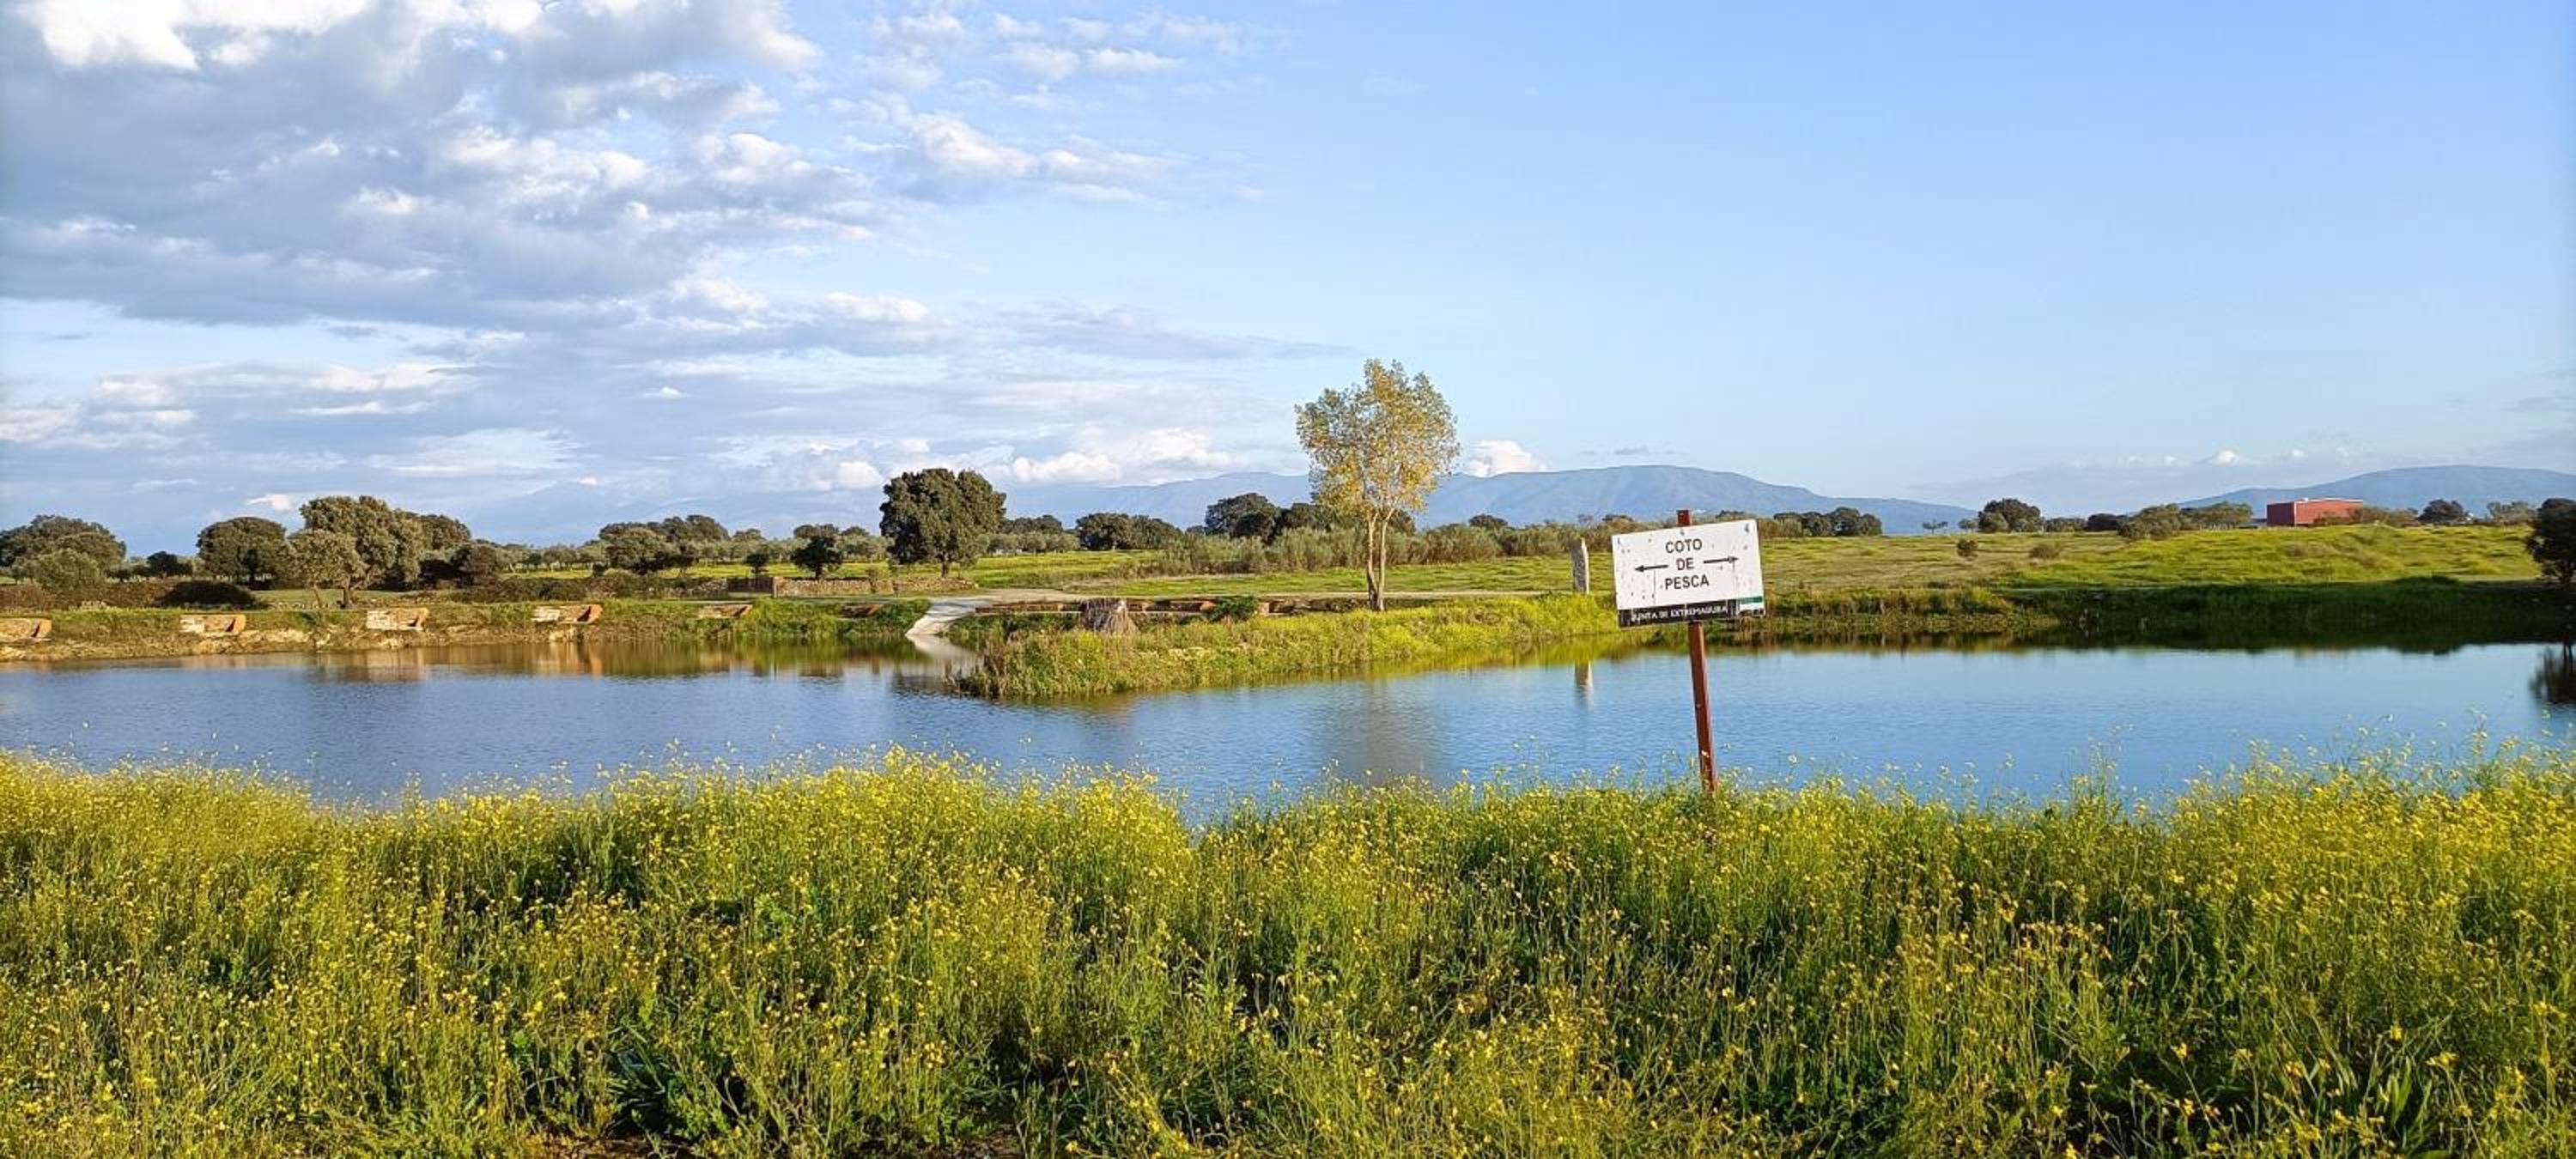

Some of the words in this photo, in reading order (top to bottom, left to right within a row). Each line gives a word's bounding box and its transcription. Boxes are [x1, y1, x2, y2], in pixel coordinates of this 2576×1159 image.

[1665, 538, 1703, 554] COTO
[1676, 557, 1695, 571] DE
[1665, 574, 1710, 591] PESCA
